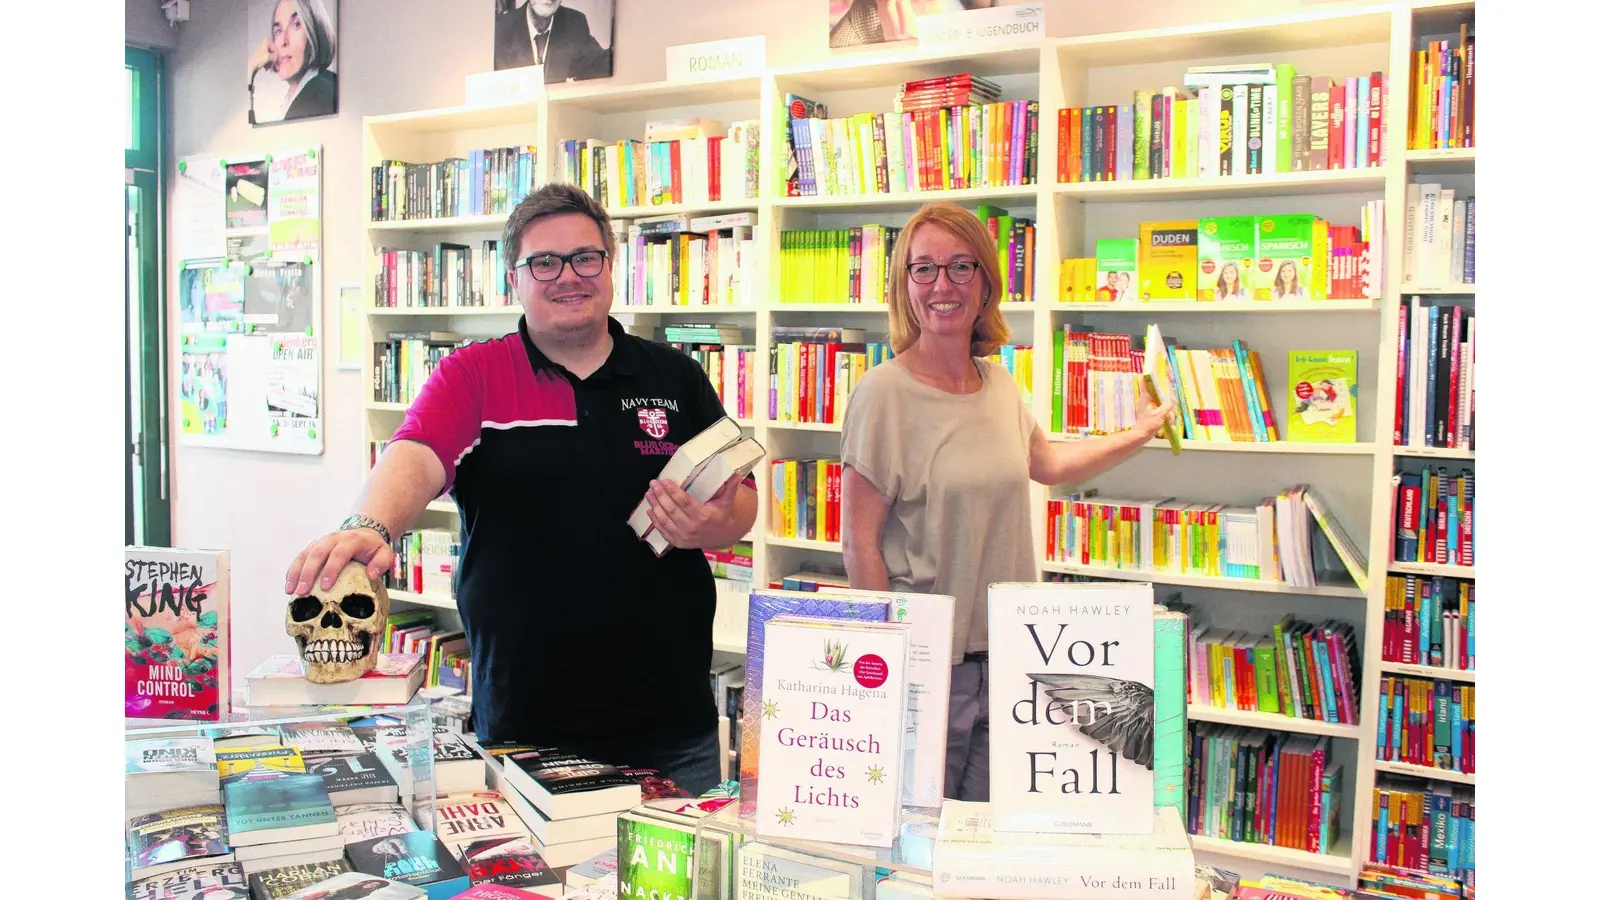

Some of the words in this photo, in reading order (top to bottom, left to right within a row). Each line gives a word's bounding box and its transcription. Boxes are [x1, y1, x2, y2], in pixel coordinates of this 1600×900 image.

[976, 22, 1039, 38] JUGENDBUCH
[689, 52, 743, 73] ROMAN
[1153, 234, 1189, 244] DUDEN
[1261, 242, 1308, 250] SPANISCH
[297, 347, 313, 360] AIR
[621, 398, 648, 411] NAVY
[650, 398, 680, 412] TEAM
[1403, 489, 1414, 528] DEUTSCHLAND
[1464, 510, 1472, 535] DRESDEN
[125, 559, 203, 583] STEPHEN
[125, 578, 208, 621] KING
[1016, 605, 1061, 616] NOAH
[1069, 605, 1132, 616] HAWLEY
[1023, 623, 1120, 667] Vor
[148, 665, 183, 681] MIND
[137, 680, 195, 698] CONTROL
[777, 678, 837, 695] Katharina
[841, 684, 888, 701] Hagena
[810, 701, 852, 723] Das
[1012, 679, 1113, 727] dem
[1437, 698, 1447, 723] Irland
[777, 727, 881, 755] Geräusch
[542, 758, 591, 767] TRAIN
[810, 758, 846, 780] des
[1025, 748, 1122, 795] Fall
[562, 769, 600, 778] GIRL
[793, 785, 860, 809] Lichts
[235, 817, 254, 826] TOT
[256, 814, 286, 823] UNTER
[288, 810, 329, 820] TANNEN
[436, 802, 499, 820] DAHL
[440, 815, 505, 836] ARNE
[1434, 813, 1446, 849] Mexiko
[628, 833, 695, 855] FRIEDRICH
[630, 845, 692, 879] ANI
[743, 856, 778, 873] ELENA
[259, 864, 341, 882] HARLAN
[472, 877, 495, 886] Der
[498, 871, 543, 882] Fänger
[743, 867, 800, 889] FERRANTE
[996, 875, 1027, 884] NOAH
[1029, 876, 1070, 885] HAWLEY
[1080, 875, 1106, 889] Vor
[1112, 875, 1142, 890] dem
[1148, 876, 1176, 890] Fall
[743, 879, 779, 896] MEINE
